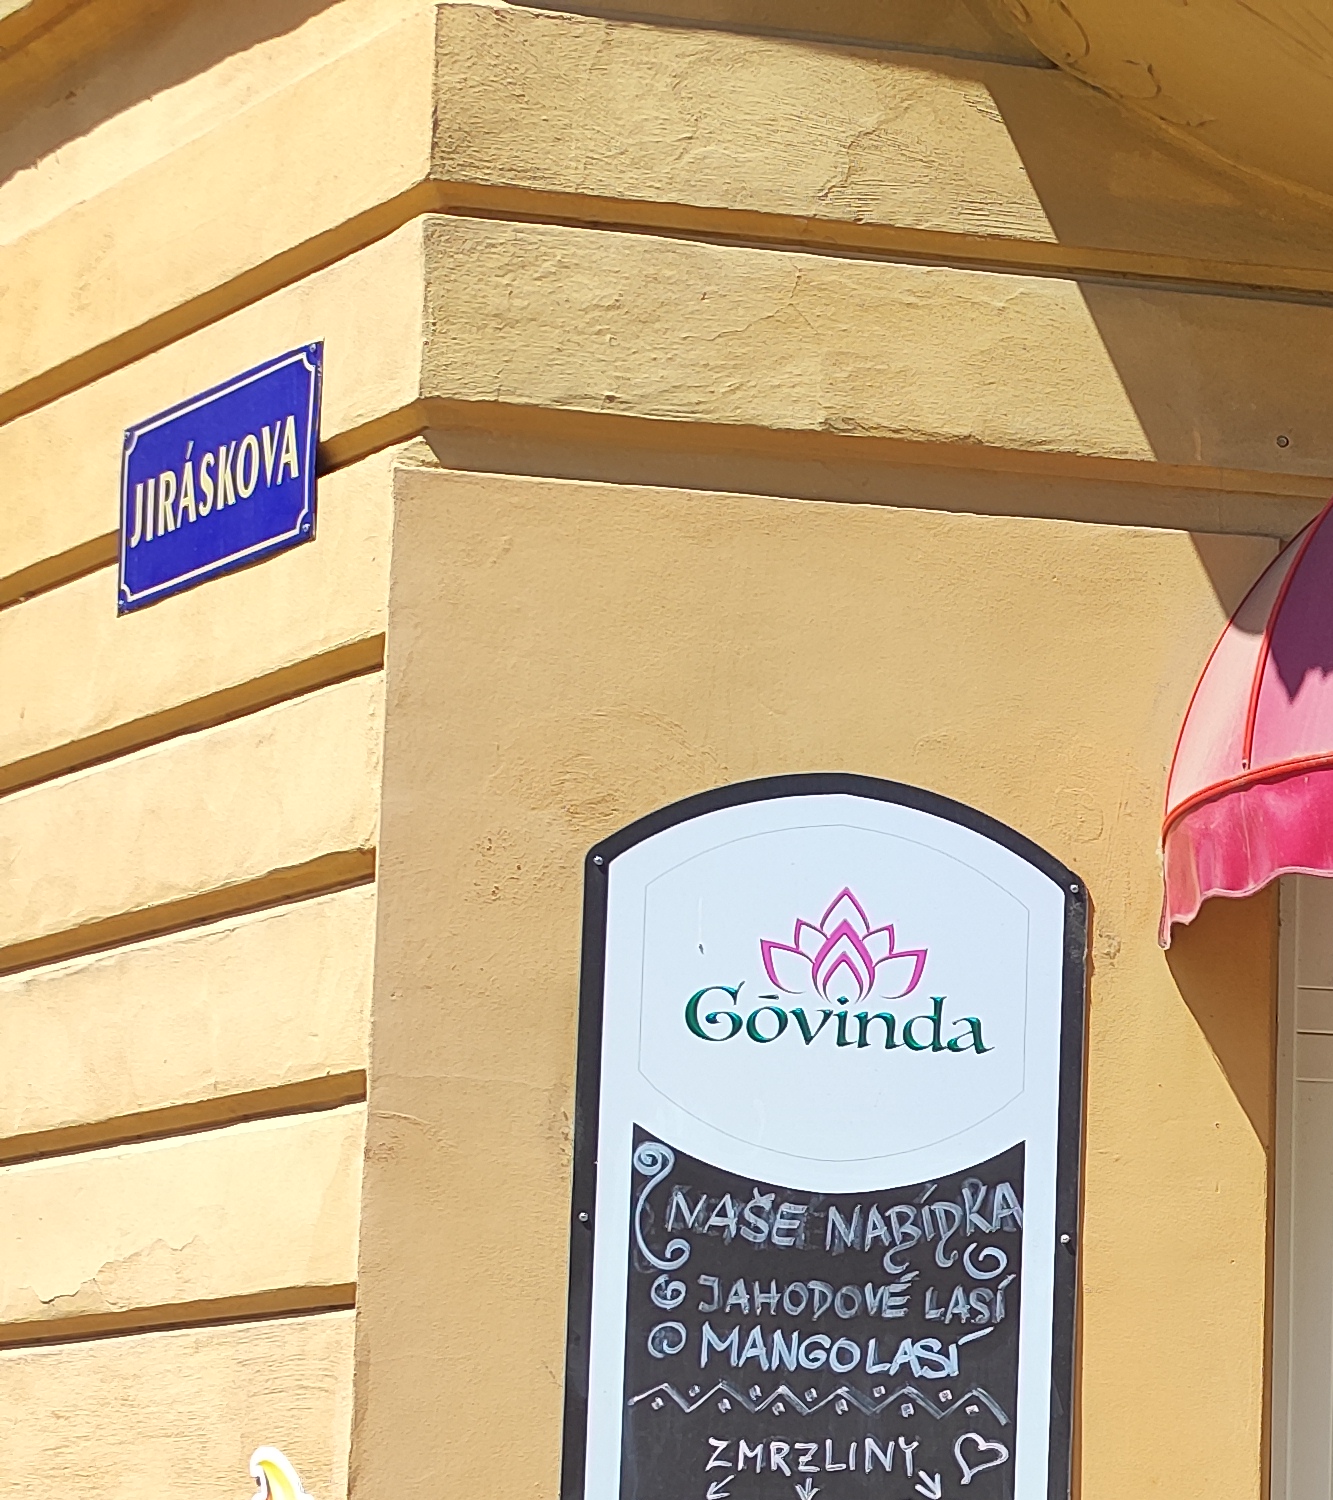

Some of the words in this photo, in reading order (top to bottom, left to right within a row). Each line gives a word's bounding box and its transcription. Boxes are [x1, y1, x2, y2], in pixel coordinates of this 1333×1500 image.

[130, 416, 300, 548] JIRÁSKOVA
[684, 981, 995, 1055] Gōvinda
[665, 1185, 809, 1245] NAŠE
[825, 1179, 1023, 1274] NABÍDKA
[697, 1270, 920, 1321] JAHODOVÉ
[924, 1273, 1017, 1324] LASÍ
[705, 1436, 920, 1476] ZMRZLINY
